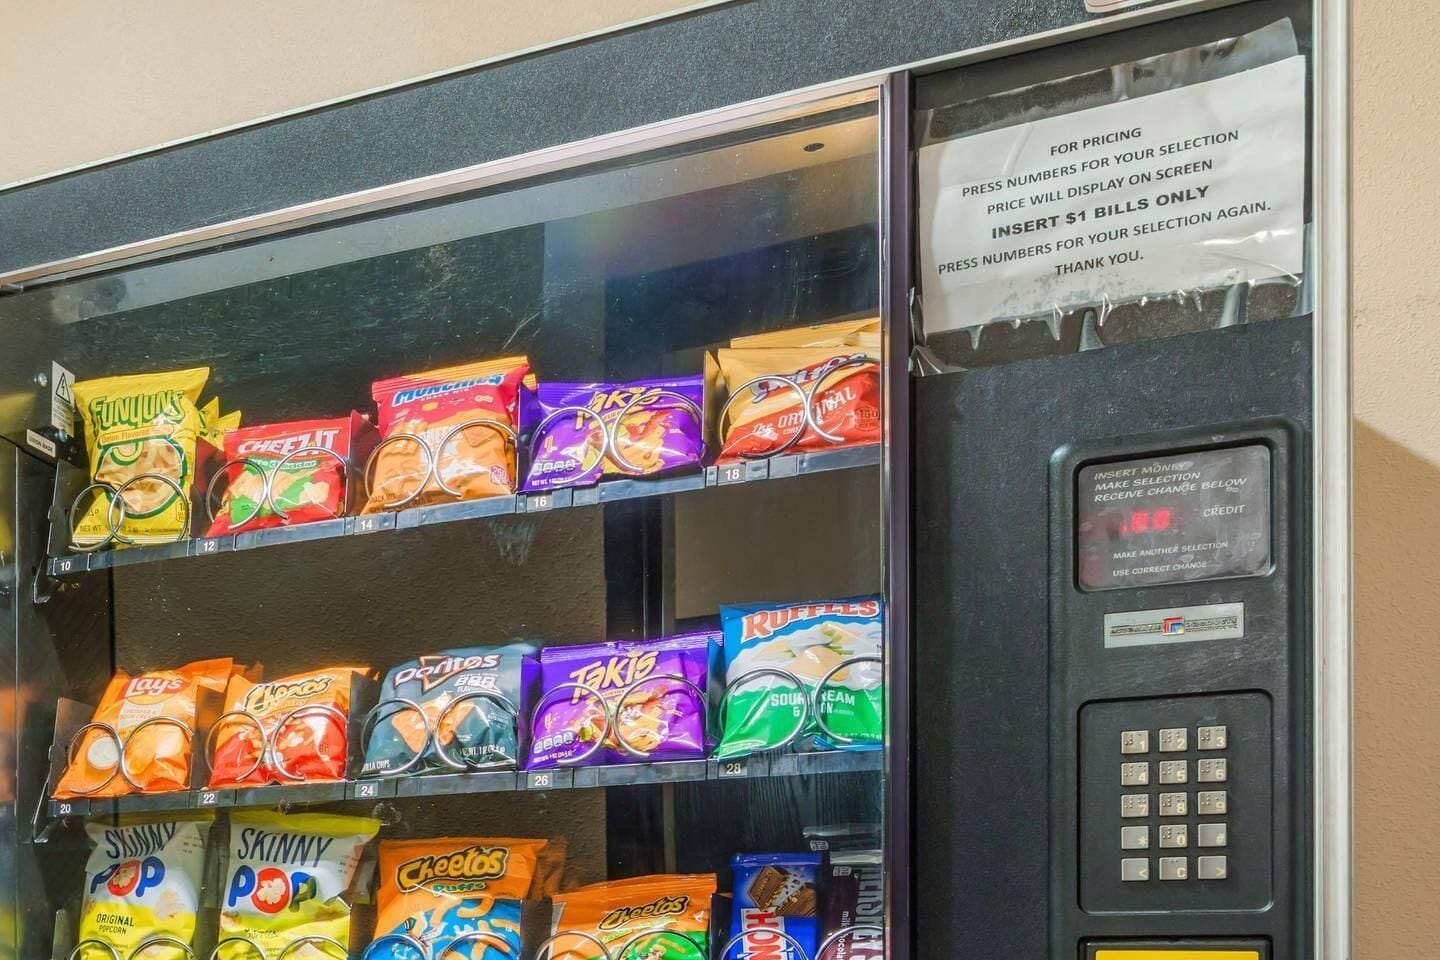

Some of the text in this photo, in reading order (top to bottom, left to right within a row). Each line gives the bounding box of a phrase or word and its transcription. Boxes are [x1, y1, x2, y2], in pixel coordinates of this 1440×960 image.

[1050, 127, 1142, 156] FOR PRICING
[962, 129, 1239, 197] PRESS NUMBERS FOR YOUR SELECTION
[987, 159, 1213, 215] PRICE WILL DISPLAY ON SCREEN
[992, 185, 1210, 239] INSERT $1 BILLS ONLY
[938, 201, 1271, 275] PRESS NUMBERS FOR YOUR SELECTION AGAIN.
[1055, 250, 1144, 276] THANK YOU.
[88, 389, 185, 437] FUNYUNS
[725, 468, 740, 480] 18
[1094, 462, 1187, 481] INSERT MONEY
[1094, 472, 1201, 491] MAKE SELECTION
[1094, 478, 1248, 502] RECEIVE CHANGE BELOW
[534, 496, 547, 508] 16
[1203, 504, 1246, 518] CREDIT
[361, 520, 373, 530] 14
[203, 541, 215, 551] 12
[1113, 541, 1229, 560] MAKE ANOTHER SELECTION
[60, 561, 71, 572] 10
[1112, 560, 1208, 577] USE CORRECT CHANGE
[743, 600, 880, 643] RUFFLES
[393, 654, 503, 690] Doritos
[126, 677, 183, 697] Lay's
[811, 690, 856, 706] REAM
[726, 763, 741, 774] 28
[361, 785, 374, 796] 24
[535, 776, 548, 786] 26
[203, 793, 214, 803] 22
[60, 803, 71, 814] 20
[105, 822, 177, 859] SKINNY
[238, 827, 335, 868] SKINNY
[90, 856, 166, 898] POP
[397, 846, 509, 892] Cheetos
[228, 864, 317, 914] POP
[96, 913, 135, 927] ORIGINAL
[598, 895, 690, 931] Cheetos
[98, 924, 127, 935] POPCORN
